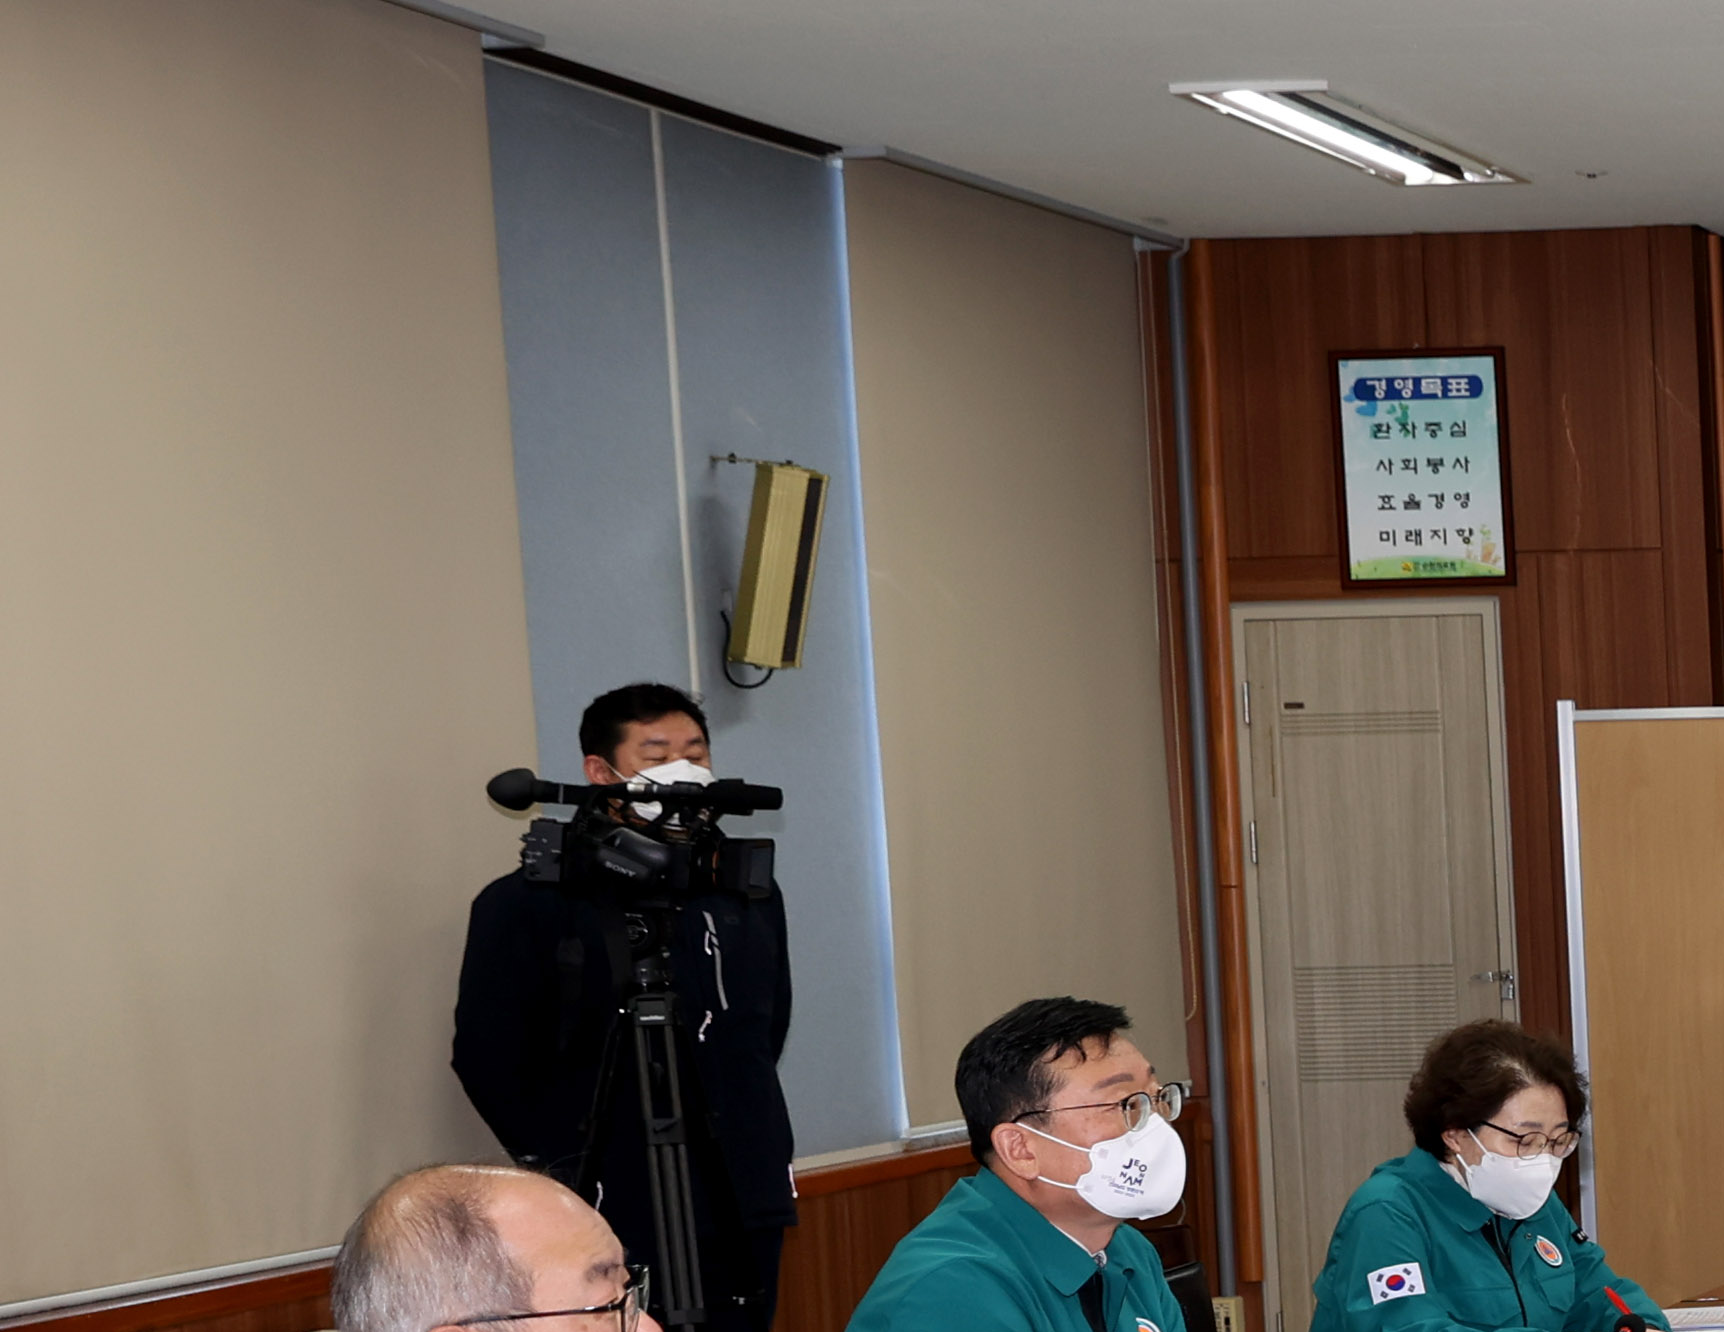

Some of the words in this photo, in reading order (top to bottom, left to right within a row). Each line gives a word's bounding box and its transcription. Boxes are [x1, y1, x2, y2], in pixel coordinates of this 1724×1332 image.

[1366, 377, 1471, 399] 경영목표
[1371, 420, 1468, 440] 환자중심
[1375, 455, 1471, 475] 사회봉사
[1379, 527, 1475, 547] 미래지향
[605, 861, 636, 877] SONY
